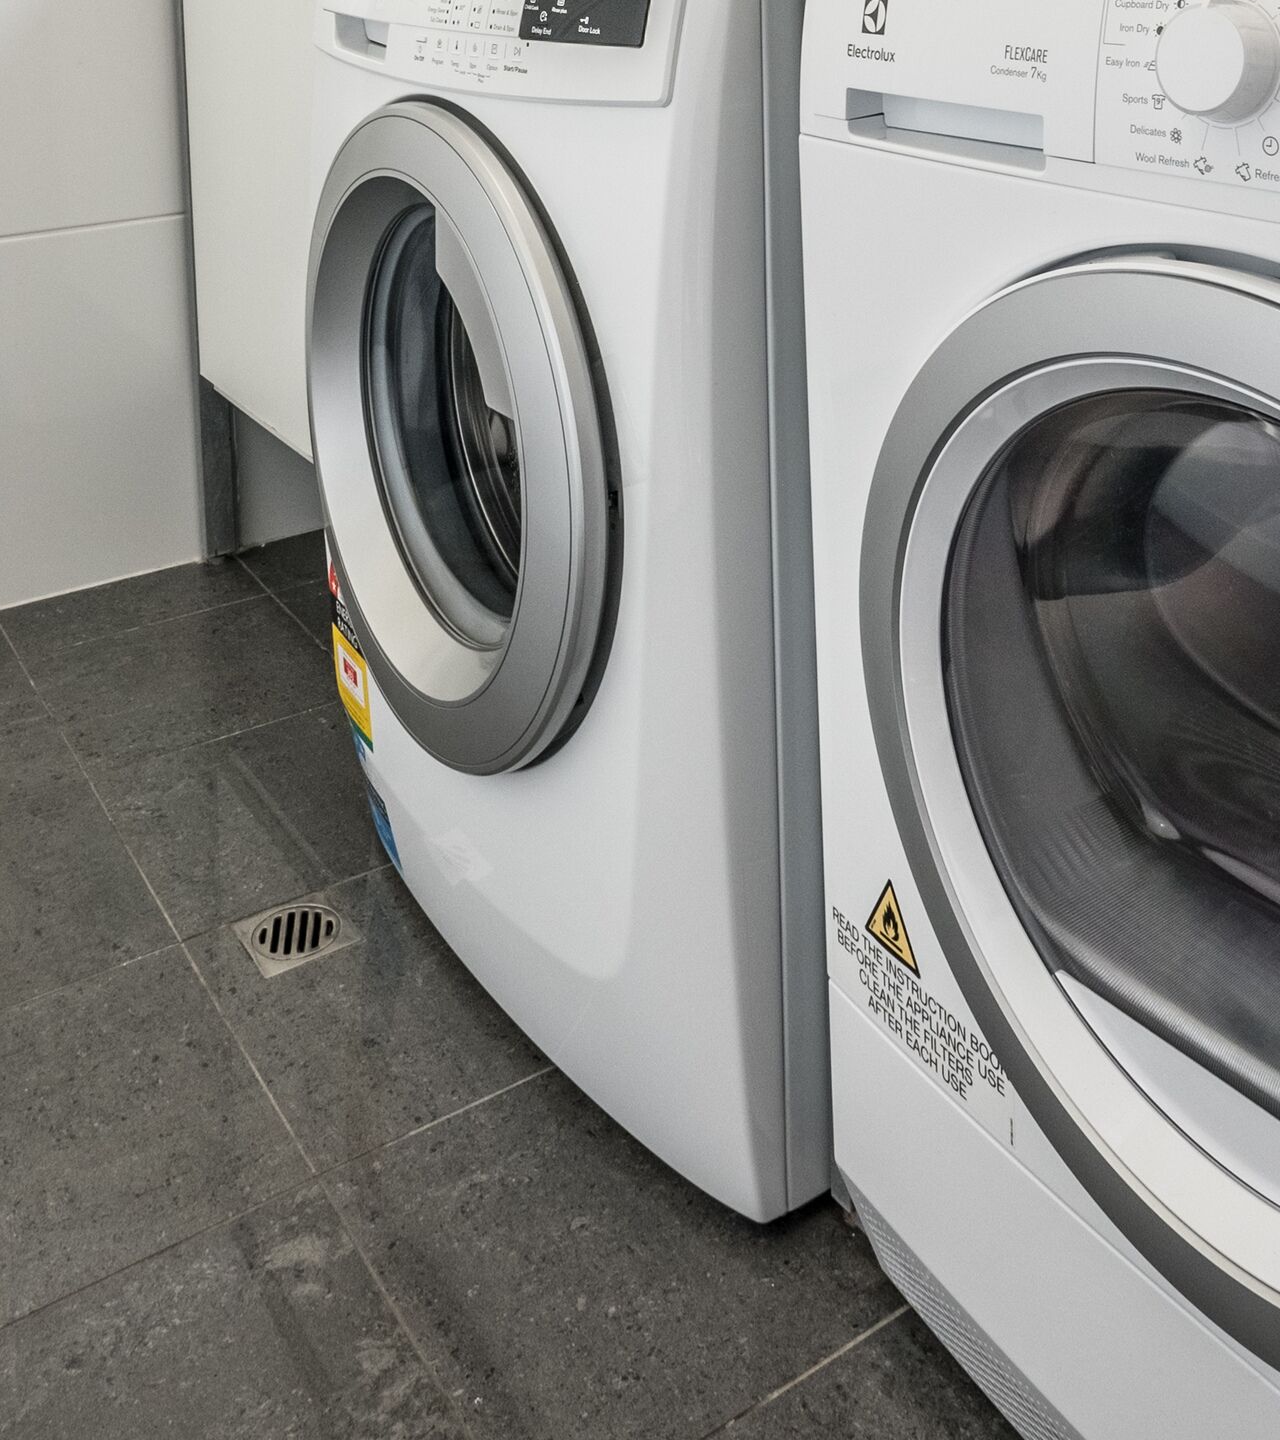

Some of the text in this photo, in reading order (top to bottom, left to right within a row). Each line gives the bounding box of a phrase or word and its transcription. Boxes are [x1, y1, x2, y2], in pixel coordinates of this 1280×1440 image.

[1155, 0, 1170, 12] Dry
[531, 26, 552, 35] Delay End
[578, 25, 601, 35] Door Lock
[1120, 23, 1150, 36] Iron Dry
[847, 43, 896, 62] Electrolux
[1004, 45, 1048, 64] FLEXCARE
[503, 64, 528, 74] Start/Pause
[1105, 56, 1140, 69] Easy Iron
[990, 64, 1028, 78] Condenser
[1122, 93, 1149, 105] Sports
[1130, 124, 1167, 138] Delicates
[1135, 152, 1190, 169] Wool Refresh
[832, 906, 860, 942] READ
[862, 933, 884, 967] THE
[885, 957, 966, 1042] INSTRUCTION
[837, 928, 1005, 1097] BEFORE THE APPLIANCE USE
[859, 968, 973, 1086] CLEAN THE FILTERS
[868, 995, 968, 1101] AFTER EACH USE
